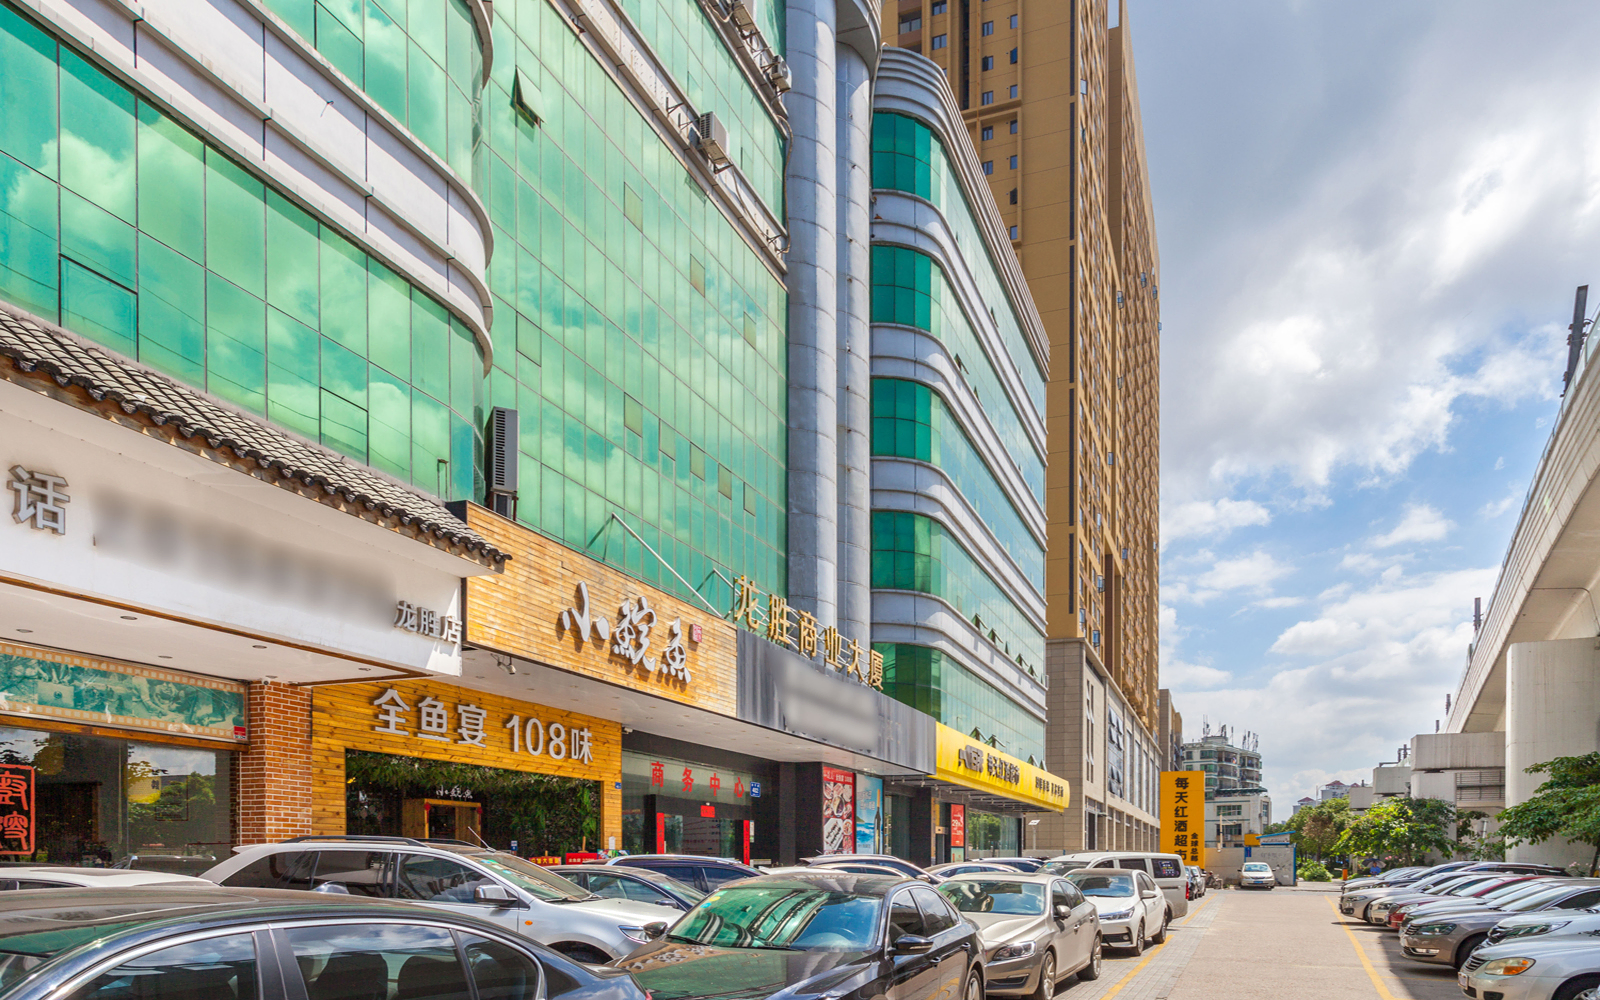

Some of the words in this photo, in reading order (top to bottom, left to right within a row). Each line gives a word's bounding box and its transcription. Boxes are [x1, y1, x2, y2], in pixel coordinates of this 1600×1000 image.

[6, 465, 70, 536] 话
[394, 600, 463, 645] 龙胜店
[733, 574, 884, 691] 龙胜商业大厦
[373, 688, 487, 749] 全鱼宴
[505, 714, 594, 765] 108味
[651, 761, 745, 798] 商务中心
[1174, 777, 1189, 861] 每天红酒超市
